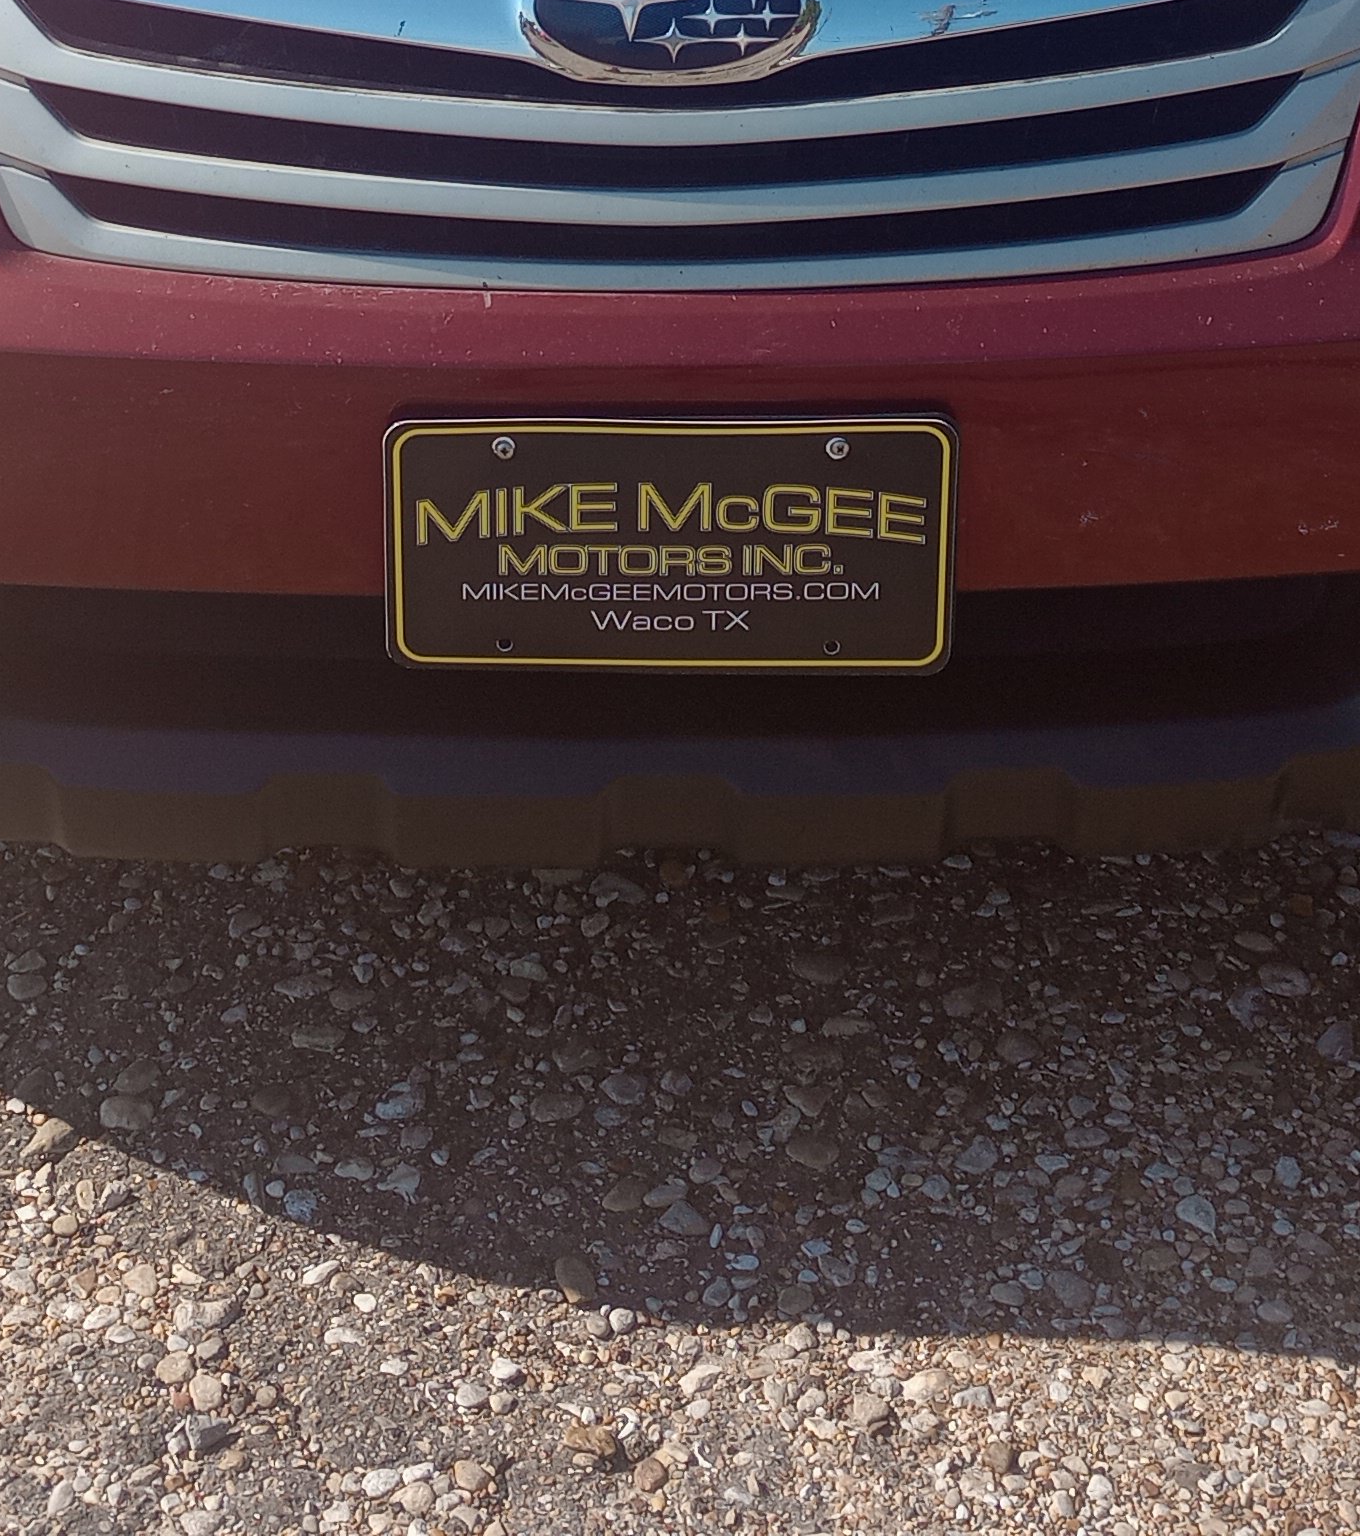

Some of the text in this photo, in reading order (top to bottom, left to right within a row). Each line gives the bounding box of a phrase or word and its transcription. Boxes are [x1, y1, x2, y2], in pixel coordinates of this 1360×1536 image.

[416, 482, 927, 546] MIKE McGEE
[498, 543, 844, 577] MOTORS INC.
[591, 610, 751, 632] Waco TX
